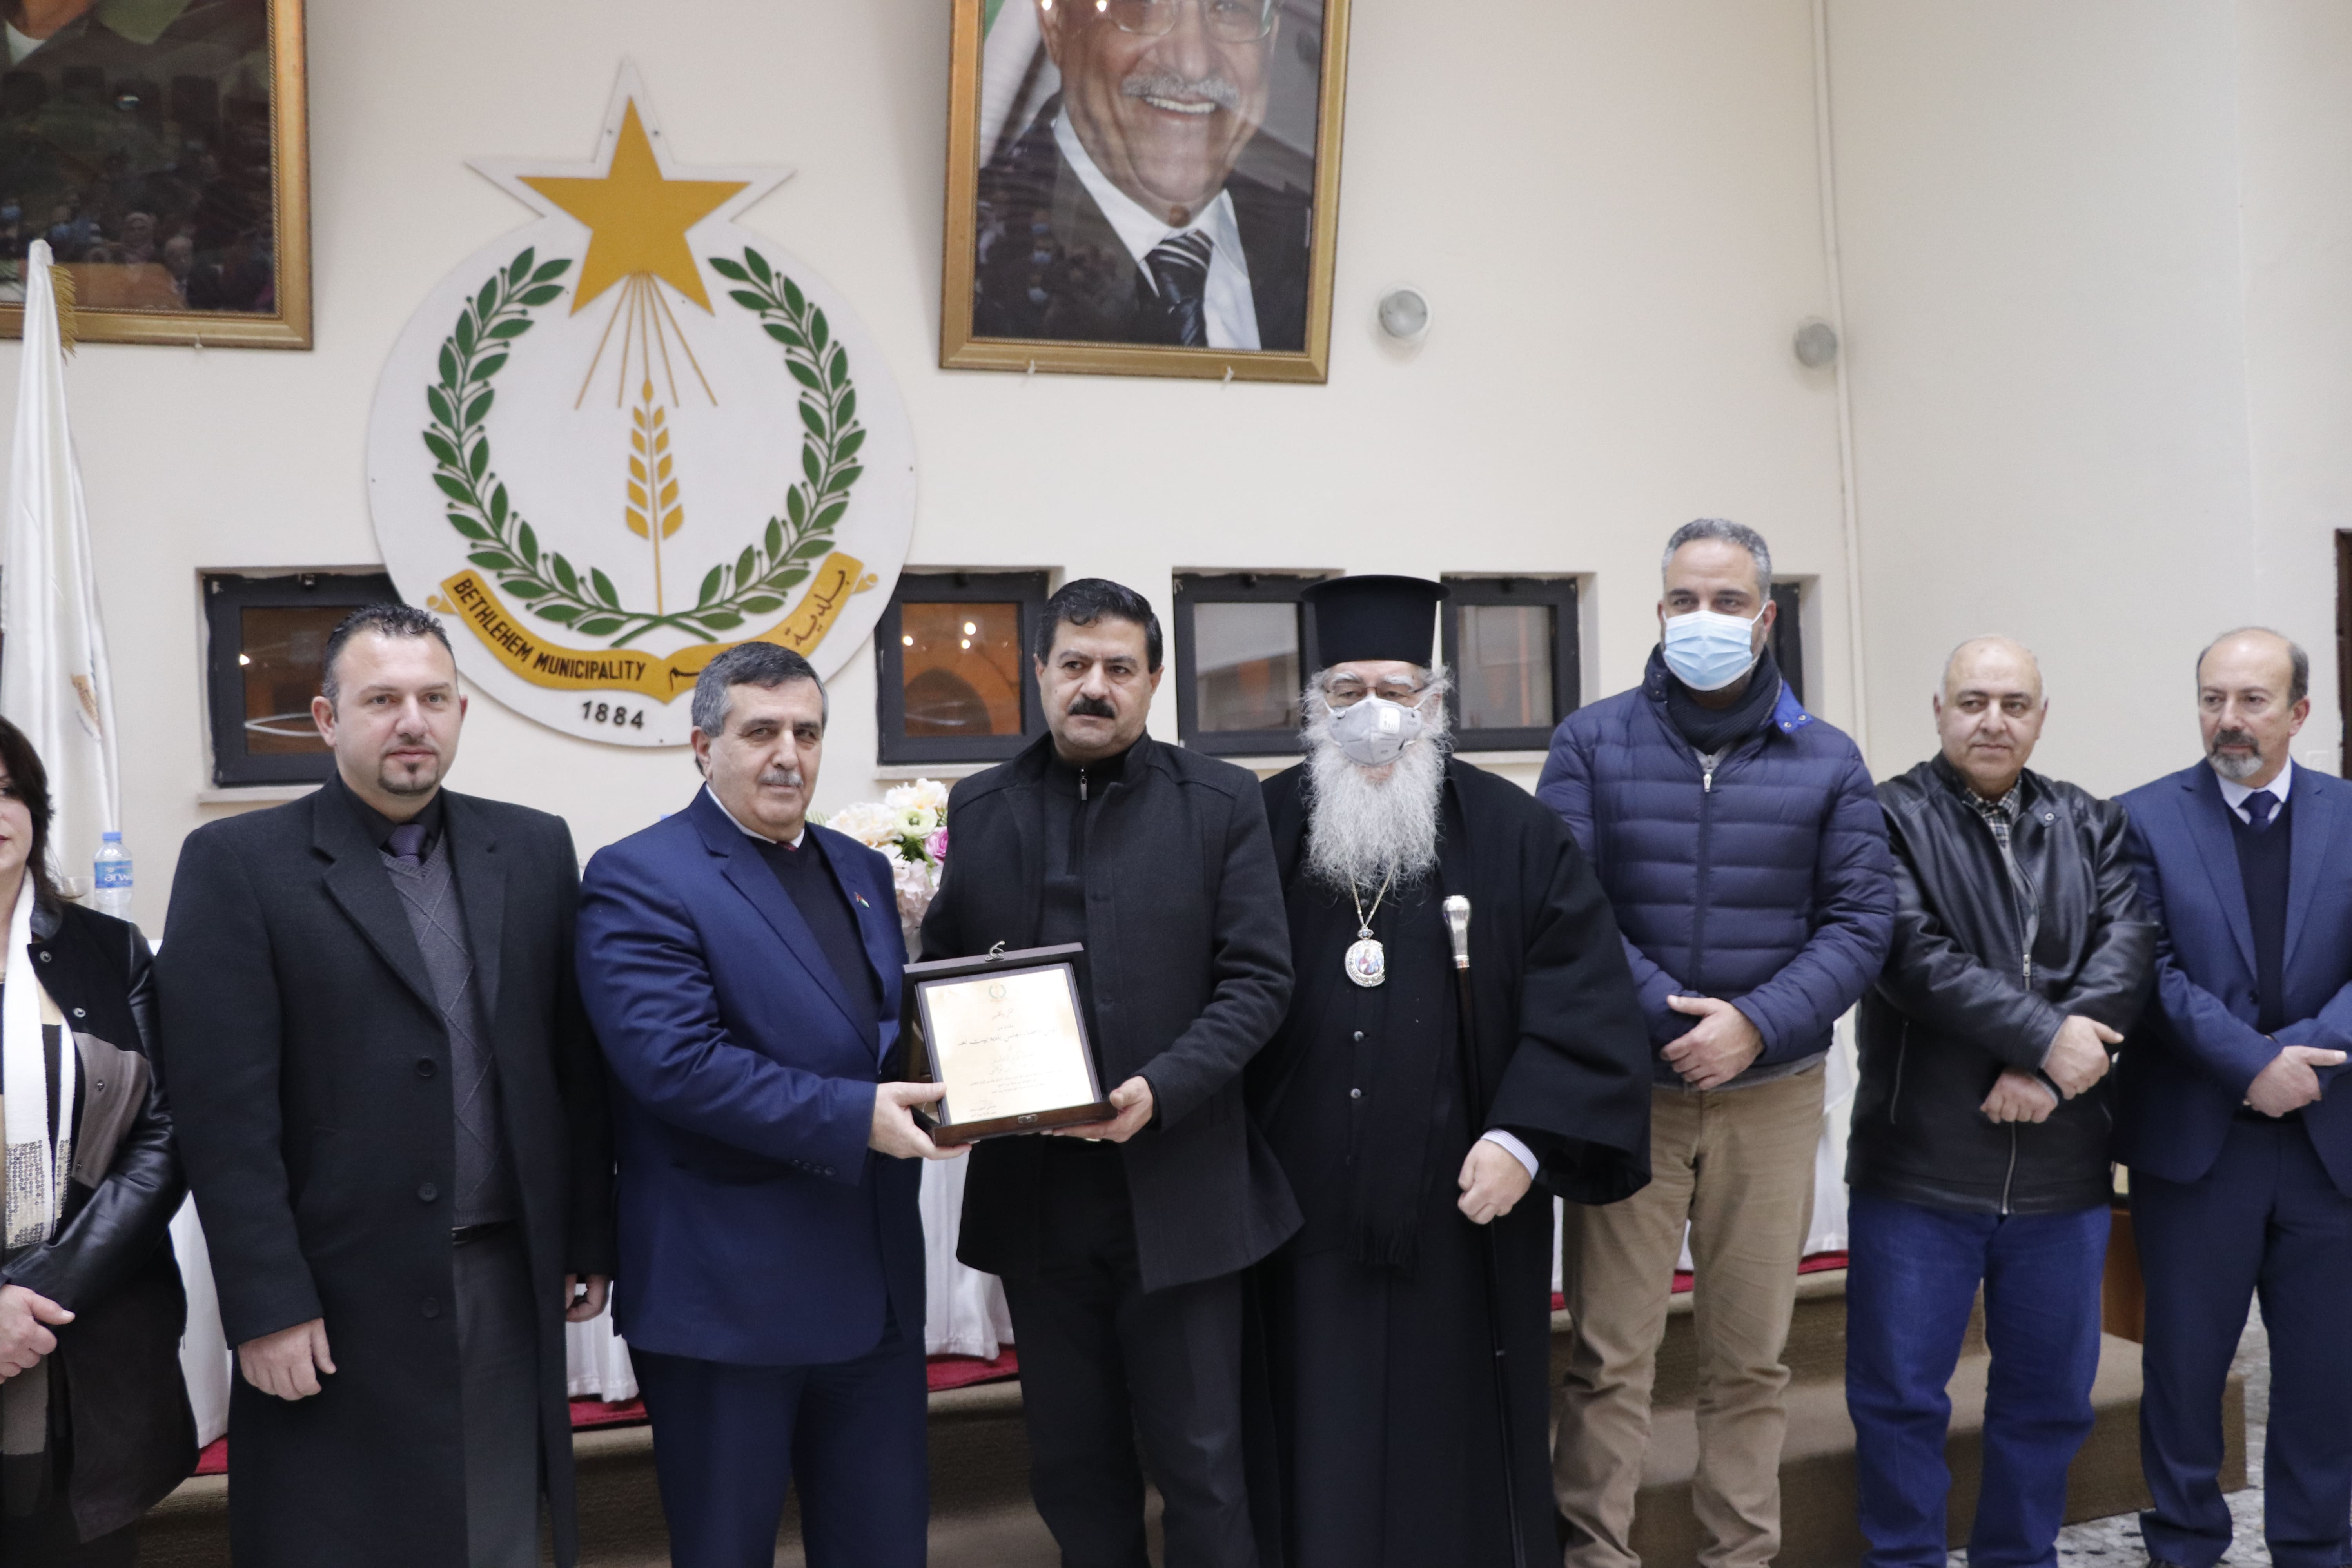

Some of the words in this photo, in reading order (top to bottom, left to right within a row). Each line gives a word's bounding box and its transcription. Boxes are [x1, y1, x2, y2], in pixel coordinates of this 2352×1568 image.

[454, 577, 534, 662] BETHLEHEM
[532, 652, 647, 681] MUNICIPALITY
[785, 569, 851, 646] بلدية
[582, 700, 644, 729] 1884
